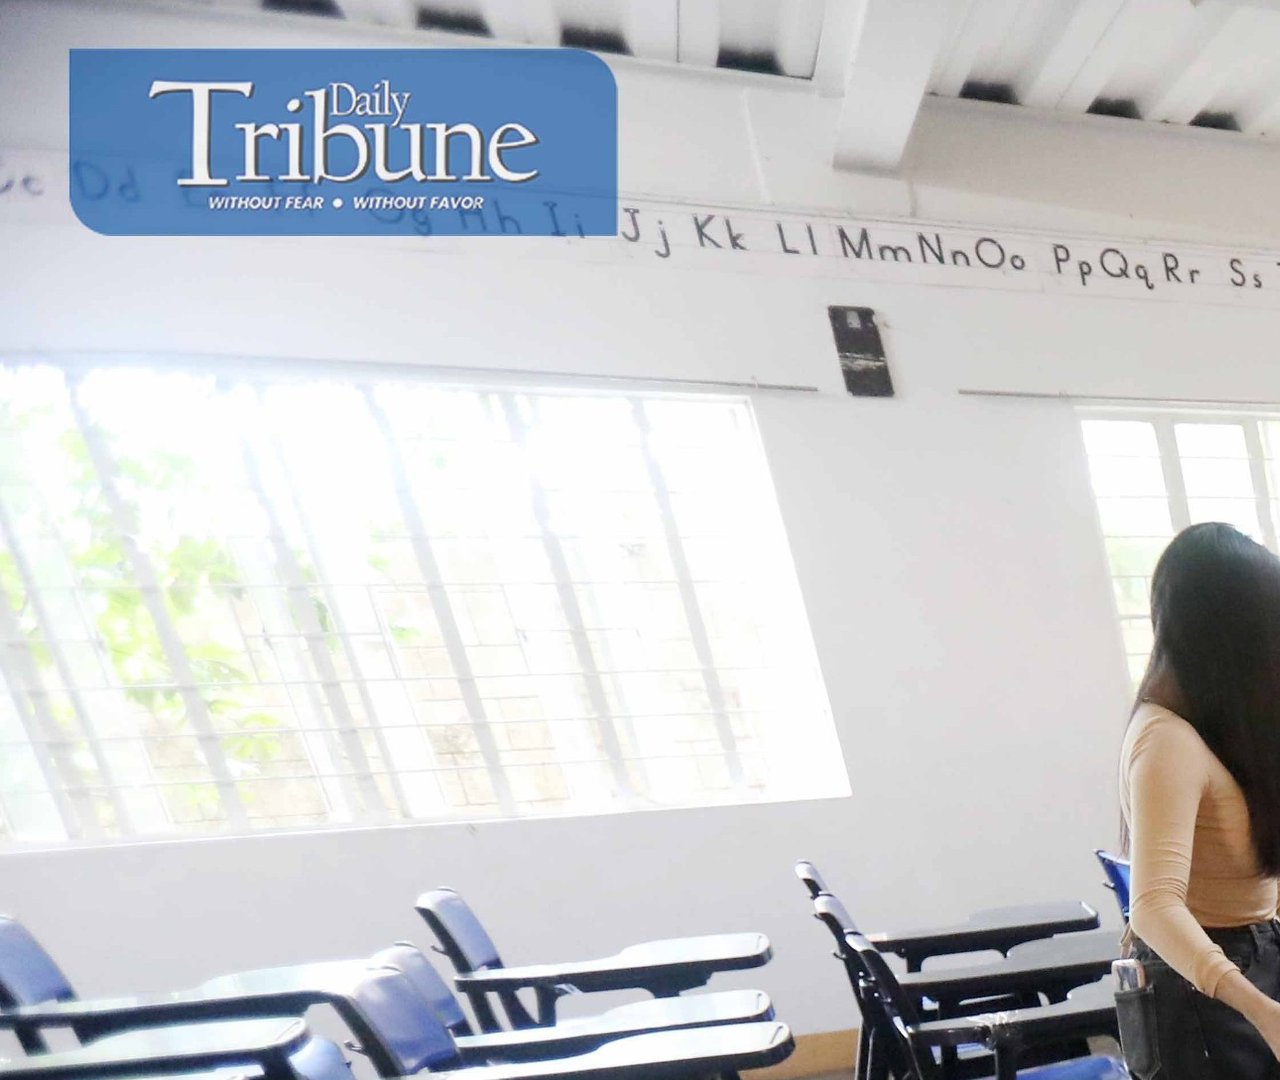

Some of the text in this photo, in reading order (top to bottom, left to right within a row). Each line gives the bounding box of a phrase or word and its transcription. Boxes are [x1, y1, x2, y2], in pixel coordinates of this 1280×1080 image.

[692, 214, 749, 251] Kk
[1052, 243, 1093, 286] Pp
[1100, 248, 1155, 290] Qq
[1162, 253, 1201, 285] Rr
[1229, 258, 1263, 289] Ss
